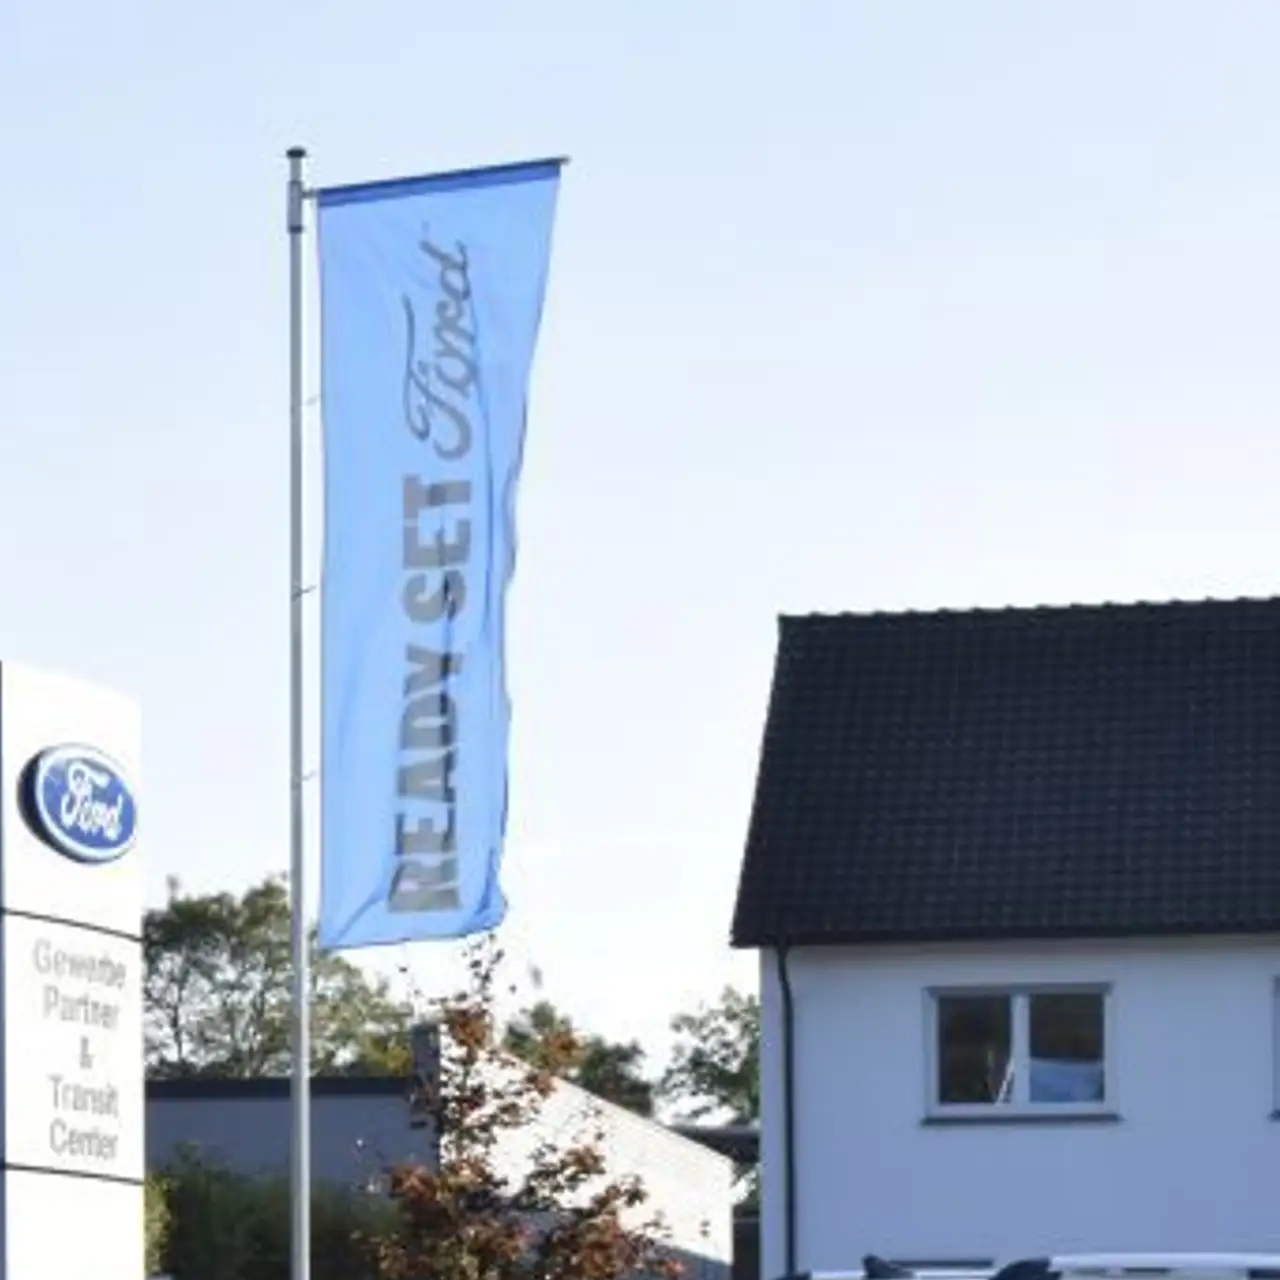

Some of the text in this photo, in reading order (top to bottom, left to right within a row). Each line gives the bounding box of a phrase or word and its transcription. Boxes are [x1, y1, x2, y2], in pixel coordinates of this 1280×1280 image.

[387, 237, 477, 913] READY SET Ford
[60, 761, 123, 840] Ford
[43, 984, 120, 1029] Partner
[46, 1073, 120, 1118] Transit
[49, 1118, 119, 1160] Center
